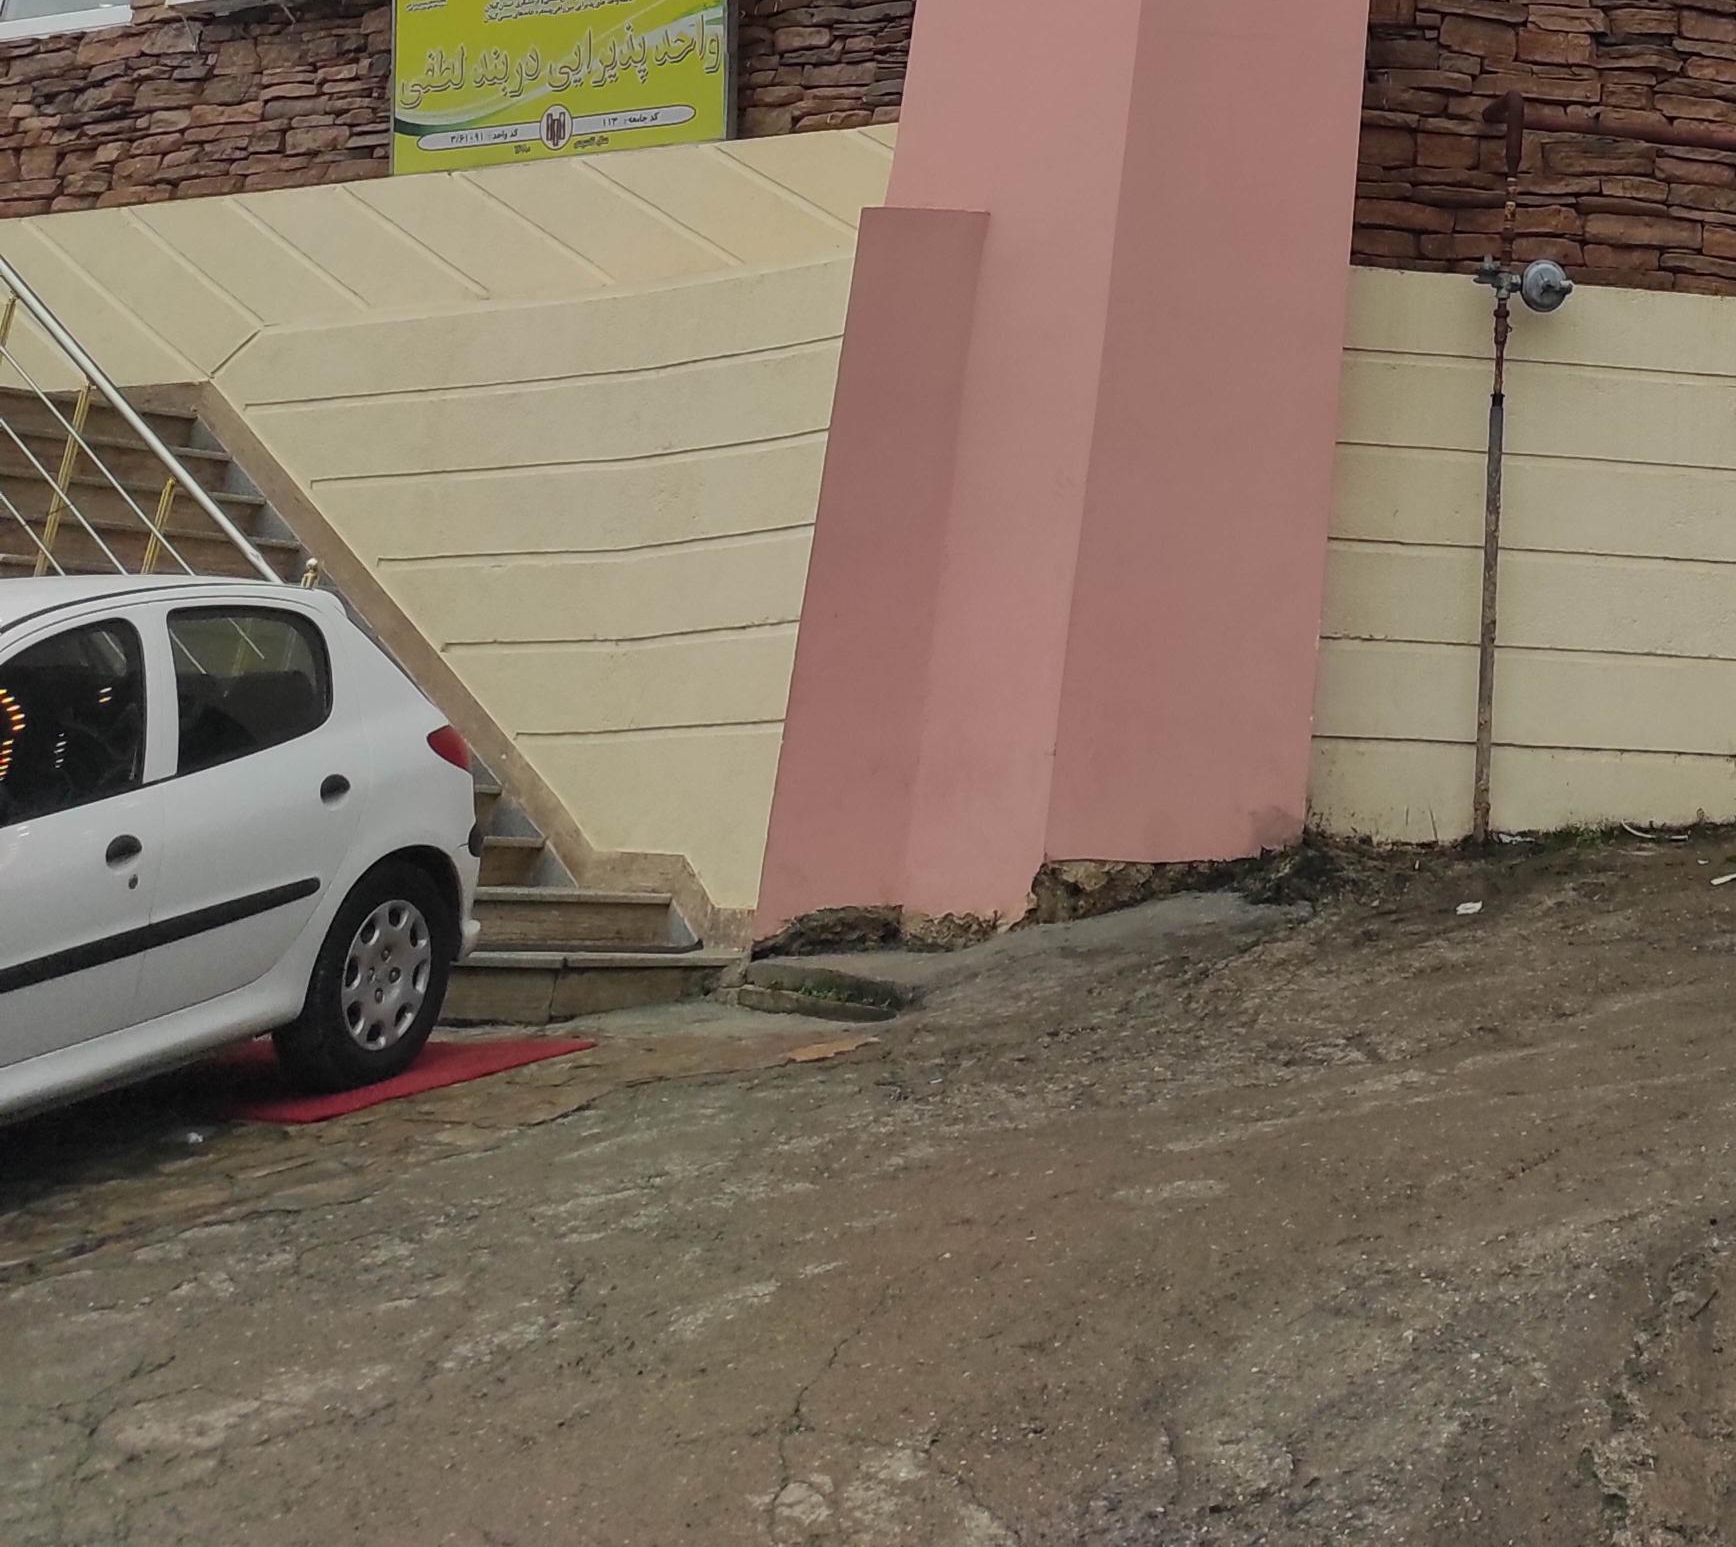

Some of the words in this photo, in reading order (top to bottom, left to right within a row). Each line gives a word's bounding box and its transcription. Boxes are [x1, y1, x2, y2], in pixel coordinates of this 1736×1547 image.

[401, 42, 465, 110] لطفی
[473, 46, 541, 97] دربند
[549, 23, 649, 92] پذیرایی
[653, 15, 722, 74] واحد
